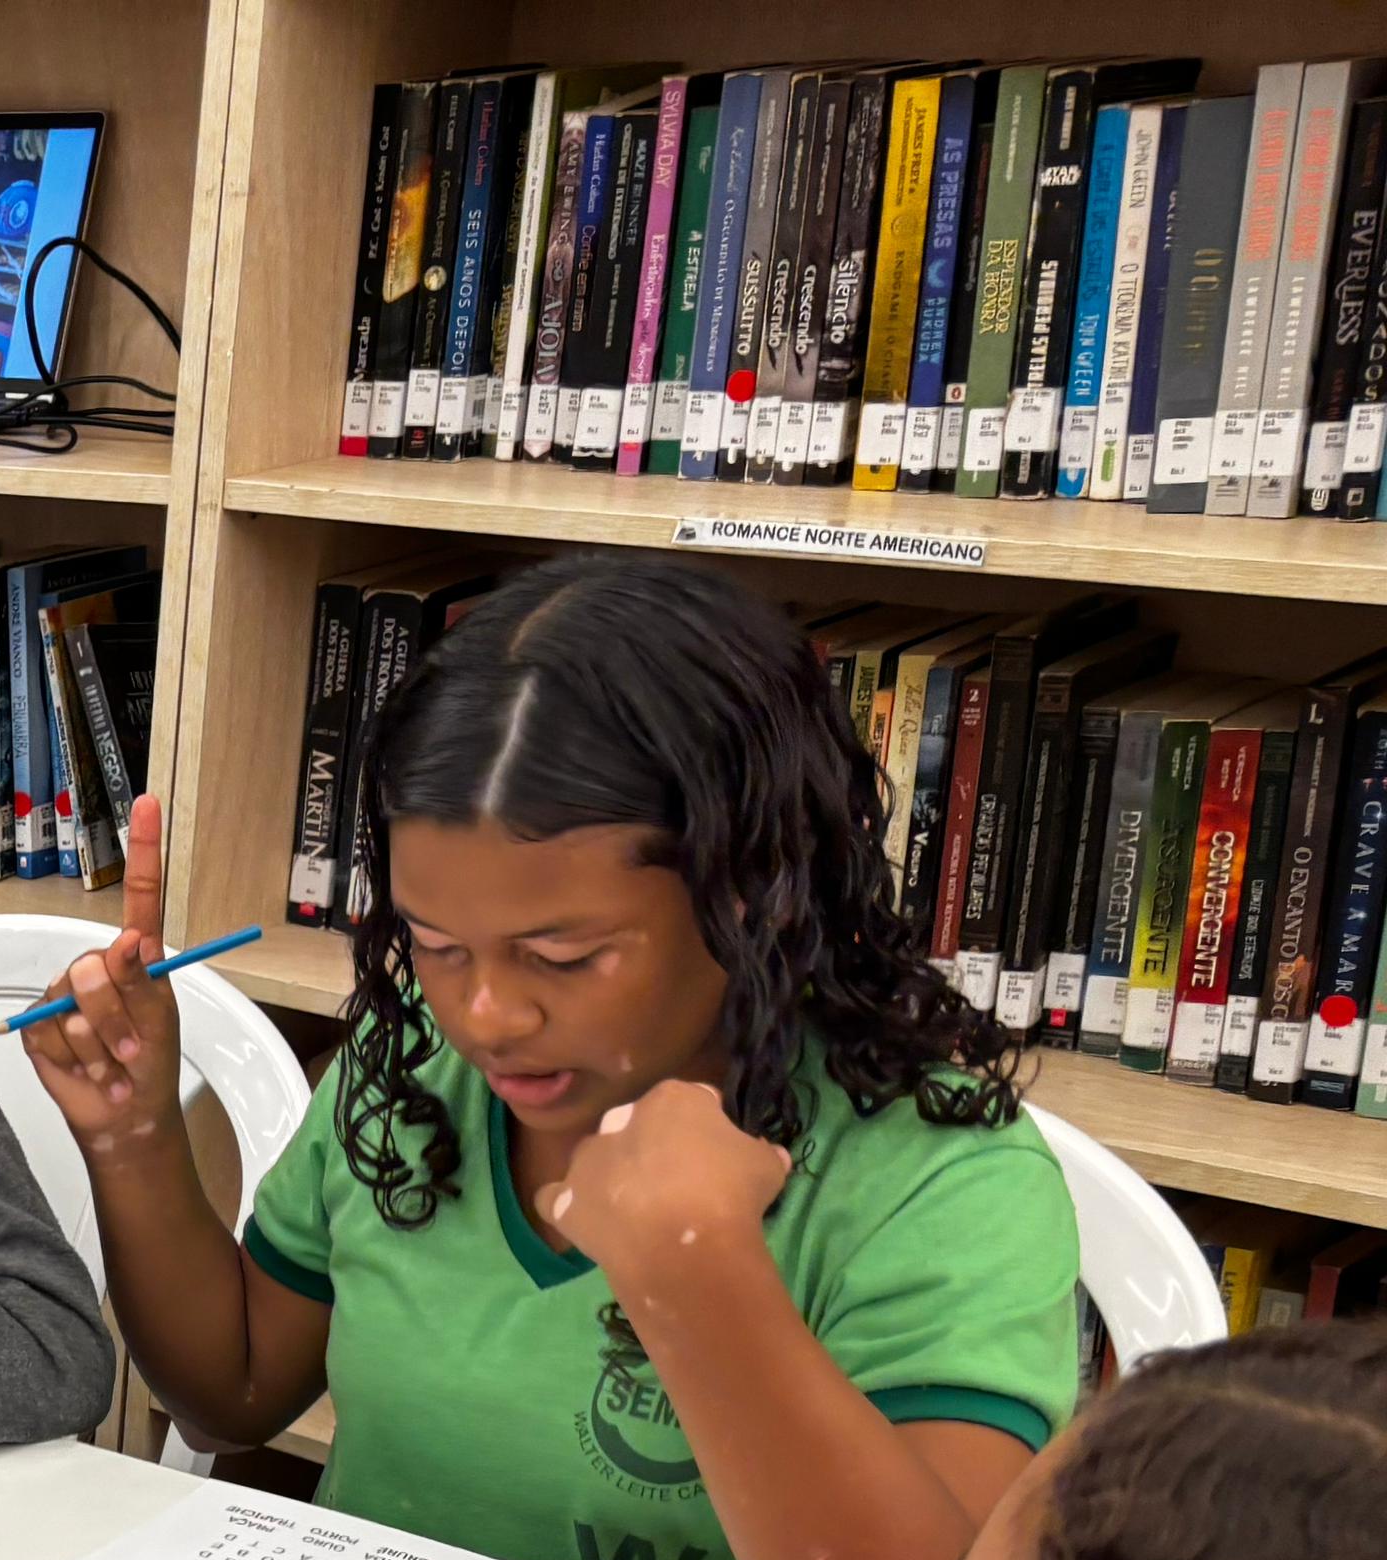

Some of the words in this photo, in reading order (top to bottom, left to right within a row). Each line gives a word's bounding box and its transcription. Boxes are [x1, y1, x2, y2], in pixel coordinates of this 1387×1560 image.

[659, 91, 681, 149] SYLVIA
[913, 109, 927, 149] JAMES
[1133, 130, 1152, 166] JOHN
[565, 141, 581, 177] AMY
[633, 139, 647, 177] MAZE
[654, 154, 674, 187] DAY
[911, 153, 923, 185] FREY
[944, 138, 963, 162] AS
[558, 185, 576, 244] EWING
[586, 175, 603, 213] Cohen
[933, 172, 959, 248] PRESAS
[1129, 169, 1148, 209] GREEN
[464, 209, 482, 249] SEIS
[577, 225, 596, 270] Confie
[987, 240, 1004, 268] DA
[458, 257, 475, 307] ANOS
[680, 246, 700, 311] ESTRELA
[767, 259, 791, 347] crescendo
[979, 273, 999, 334] HONRA
[994, 239, 1018, 334] ESPLENDOR
[1335, 210, 1377, 346] EVERLESS
[736, 260, 761, 356] sussurro
[794, 265, 817, 354] crescendo
[917, 298, 935, 362] FUKUDA
[929, 297, 947, 364] ANDREW
[1239, 277, 1262, 357] LAWRENCE
[1282, 276, 1305, 357] LAWRENCE
[711, 521, 800, 542] ROMANCE
[805, 527, 866, 548] NORTE
[869, 534, 983, 561] AMERICANO
[11, 583, 22, 628] ANDRÉ
[12, 631, 23, 679] VIANCO
[969, 689, 979, 703] 2
[13, 695, 28, 759] PENUMBRA
[95, 730, 123, 792] NEGRO
[1170, 747, 1182, 778] ROTH
[1182, 736, 1197, 791] VERONICA
[1219, 758, 1231, 788] ROTH
[1231, 746, 1247, 802] VERONICA
[304, 749, 335, 858] MARTIN
[1294, 847, 1312, 864] O
[1348, 801, 1383, 895] CRAVE
[1100, 810, 1143, 963] DIVERGENTE
[1144, 819, 1184, 977] INSURGENTE
[1191, 831, 1235, 988] CONVERGENTE
[1279, 868, 1310, 958] ENCANTO
[1272, 961, 1297, 1001] DOS
[574, 1410, 615, 1482] WALTER
[615, 1474, 672, 1502] LEITE
